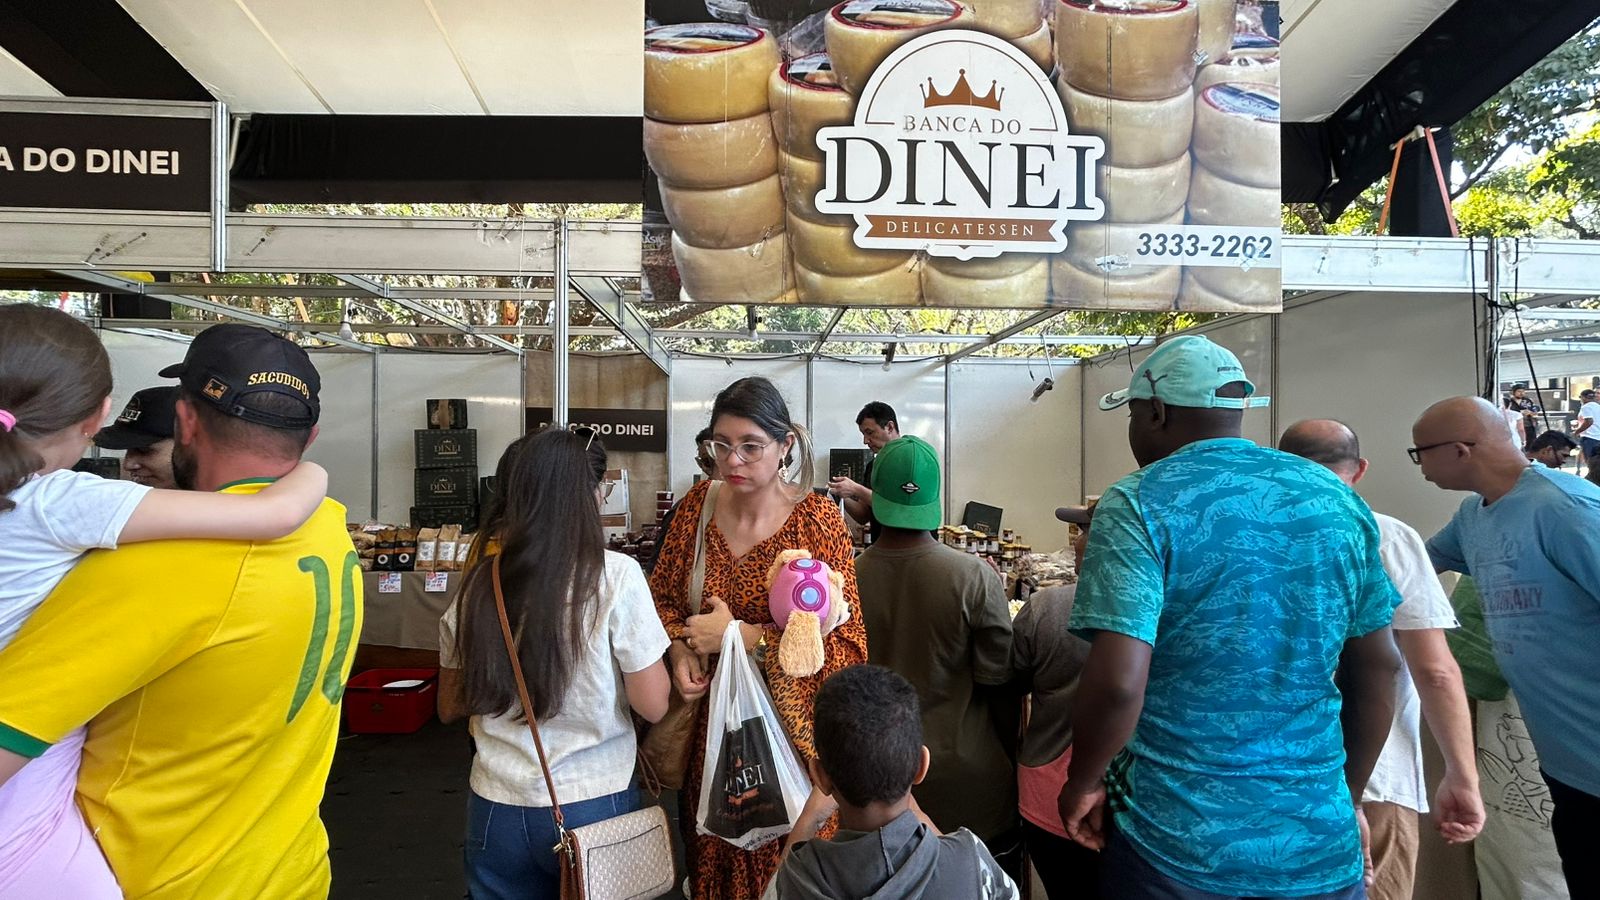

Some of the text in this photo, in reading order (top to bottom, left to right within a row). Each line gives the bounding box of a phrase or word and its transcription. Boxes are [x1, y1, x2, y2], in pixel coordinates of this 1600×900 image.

[903, 114, 1022, 135] BANCA DO
[23, 147, 76, 173] DO
[86, 148, 179, 175] DINEI
[825, 136, 1096, 210] DINEI
[886, 220, 1034, 236] DELICATESSEN
[1136, 232, 1273, 259] 3333-2262
[615, 424, 654, 436] DINEI
